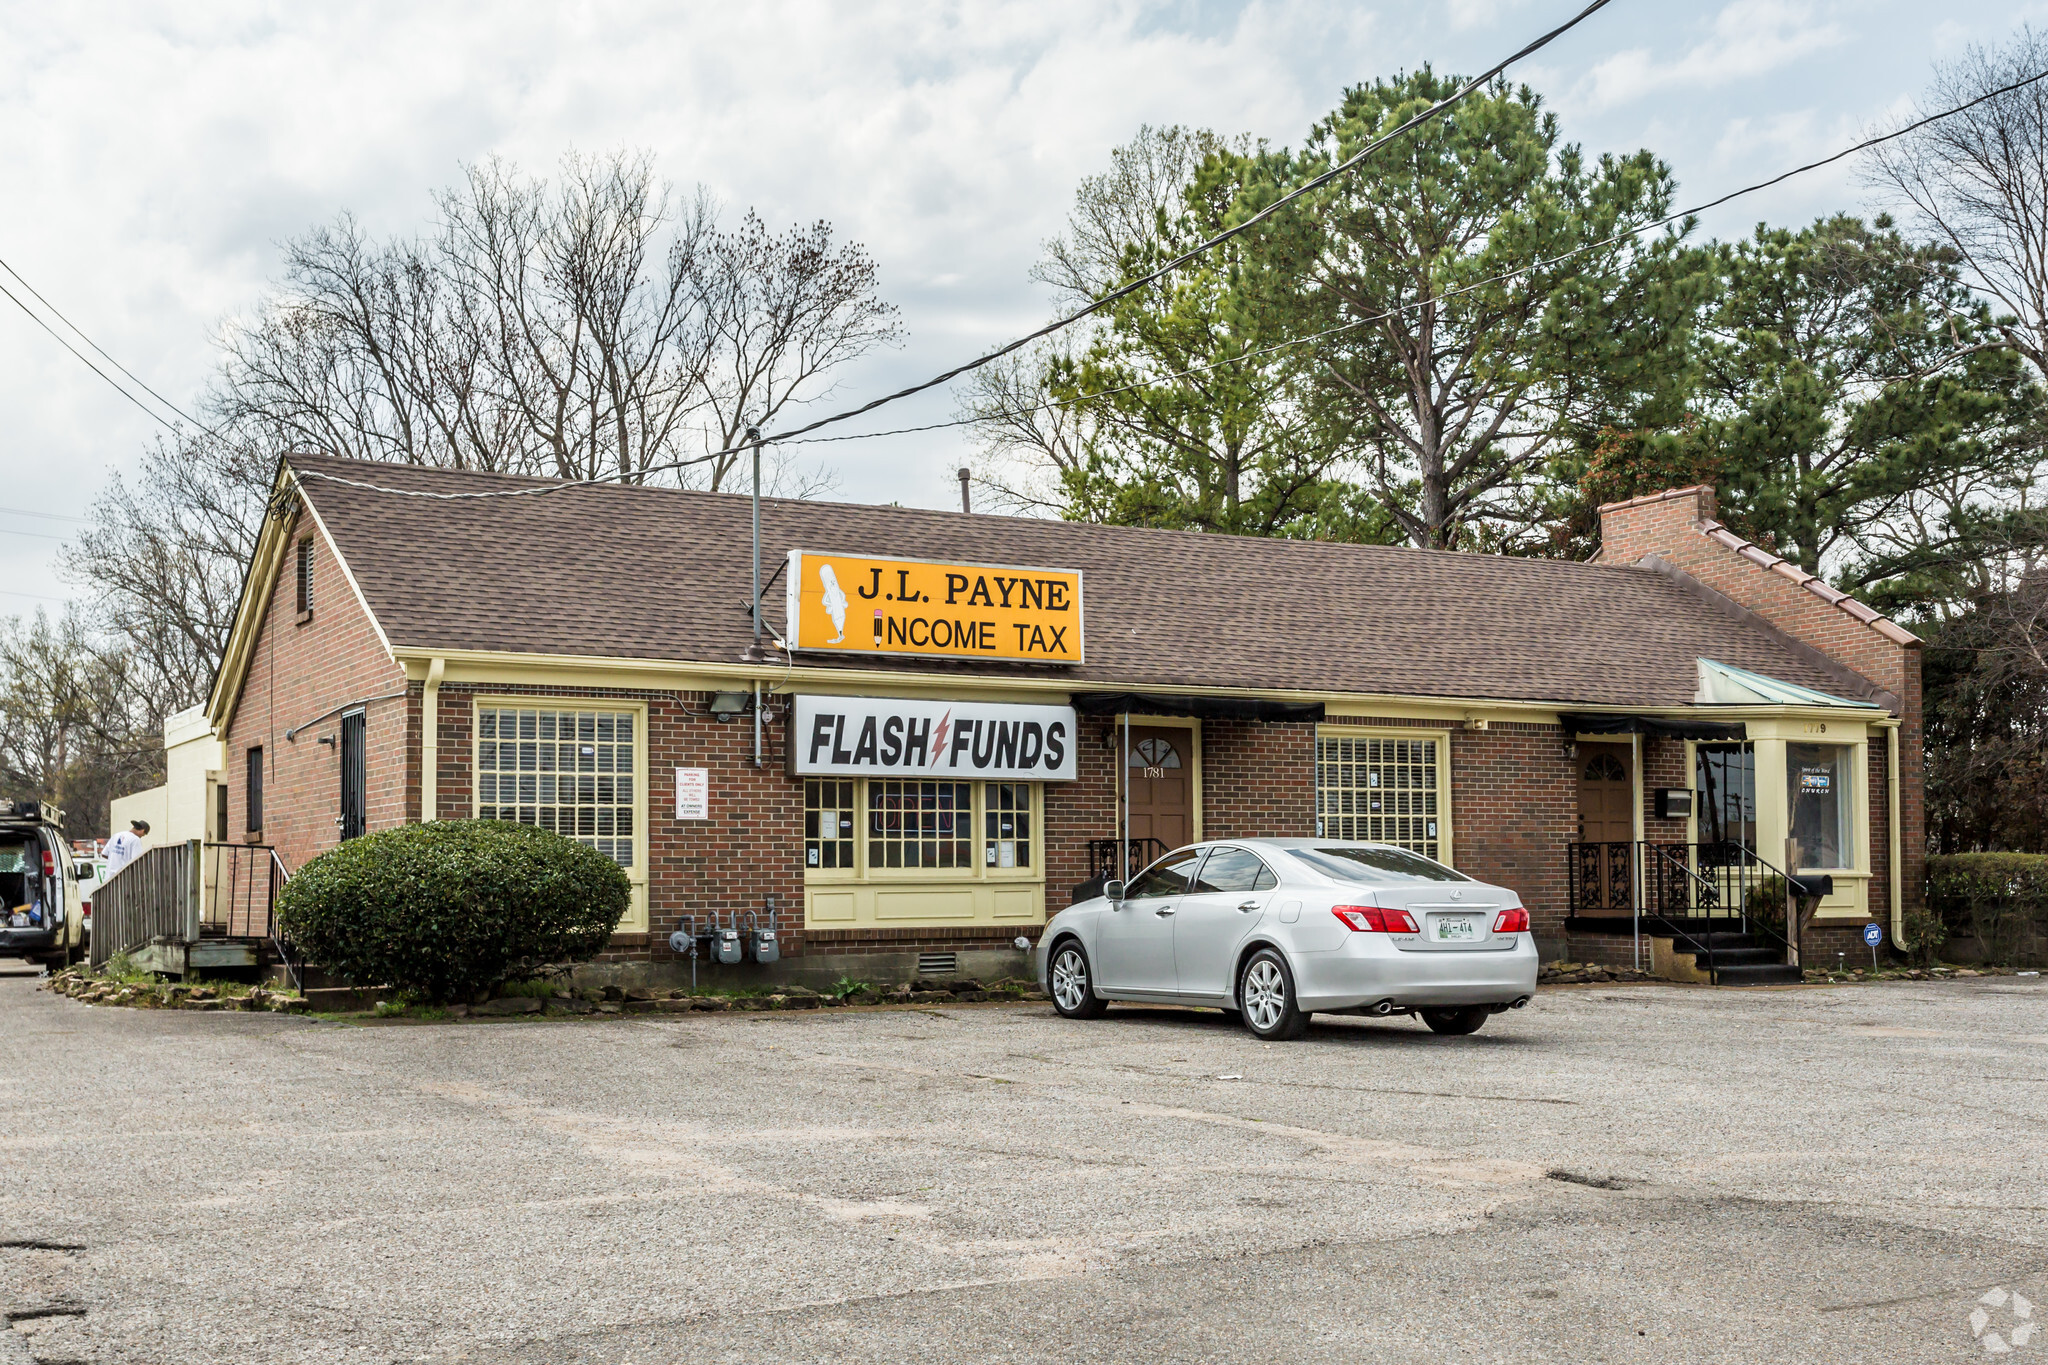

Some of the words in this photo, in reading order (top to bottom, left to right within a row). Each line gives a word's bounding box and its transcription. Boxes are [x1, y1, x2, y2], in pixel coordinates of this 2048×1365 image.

[858, 568, 930, 603] J.L.
[945, 573, 1071, 611] PAYNE
[1013, 623, 1068, 654] TAX
[808, 713, 932, 767] FLASH
[948, 718, 1067, 770] FUNDS
[1143, 766, 1165, 779] 1781
[879, 797, 952, 828] OPEN
[1866, 930, 1879, 940] ADT
